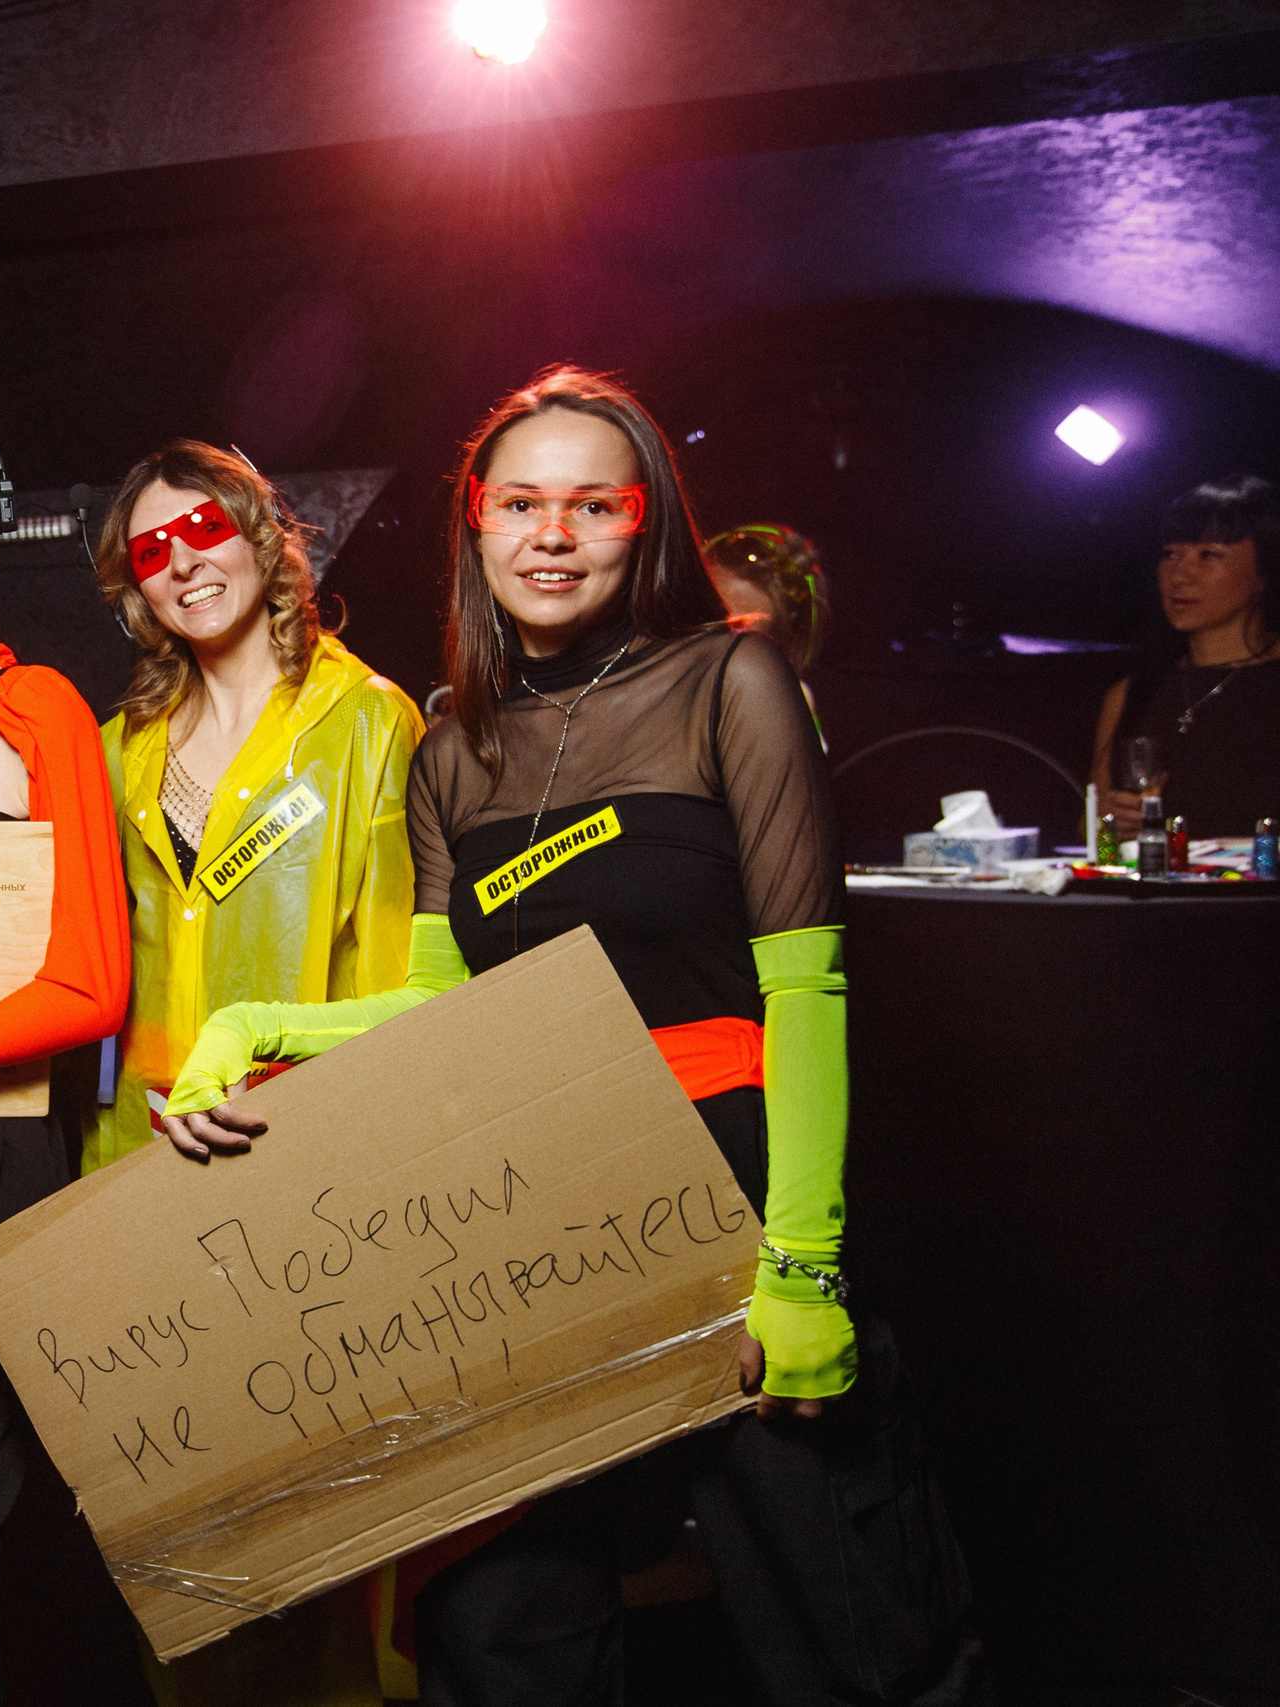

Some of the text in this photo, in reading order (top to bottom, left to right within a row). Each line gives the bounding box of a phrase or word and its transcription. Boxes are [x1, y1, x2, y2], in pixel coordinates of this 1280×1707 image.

[486, 819, 608, 900] ОСТОРОЖНО!
[37, 1158, 530, 1412] Вирус Победил
